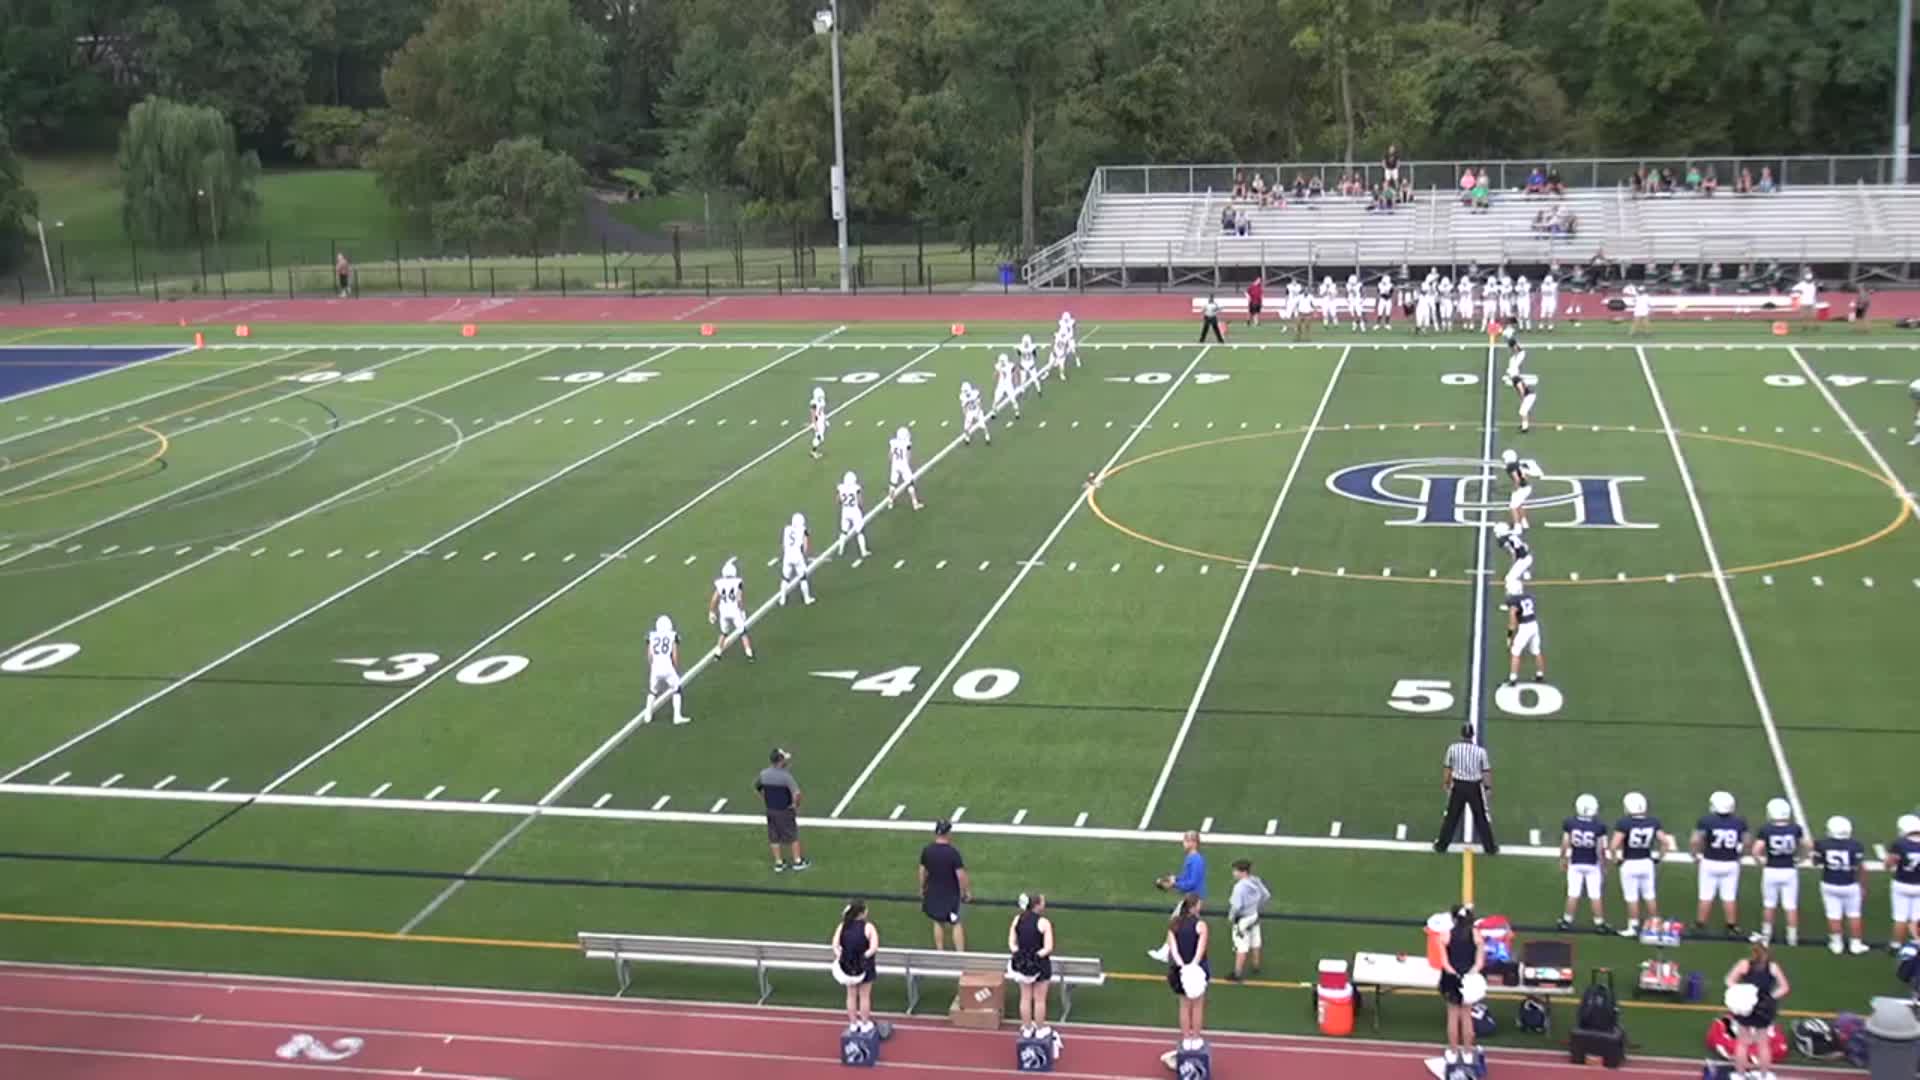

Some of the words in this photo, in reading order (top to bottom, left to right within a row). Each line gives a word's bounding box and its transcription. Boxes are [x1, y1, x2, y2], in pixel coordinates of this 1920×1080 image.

[841, 371, 936, 384] 30
[720, 587, 737, 603] 44
[652, 635, 671, 655] 28
[362, 652, 530, 684] 30
[851, 665, 1021, 700] 40
[1386, 678, 1564, 716] 50
[1570, 828, 1596, 849] 66
[1627, 826, 1655, 849] 67
[1711, 828, 1738, 849] 78
[1768, 833, 1796, 857] 50
[1824, 848, 1852, 871] 51
[1903, 851, 1920, 873] 7
